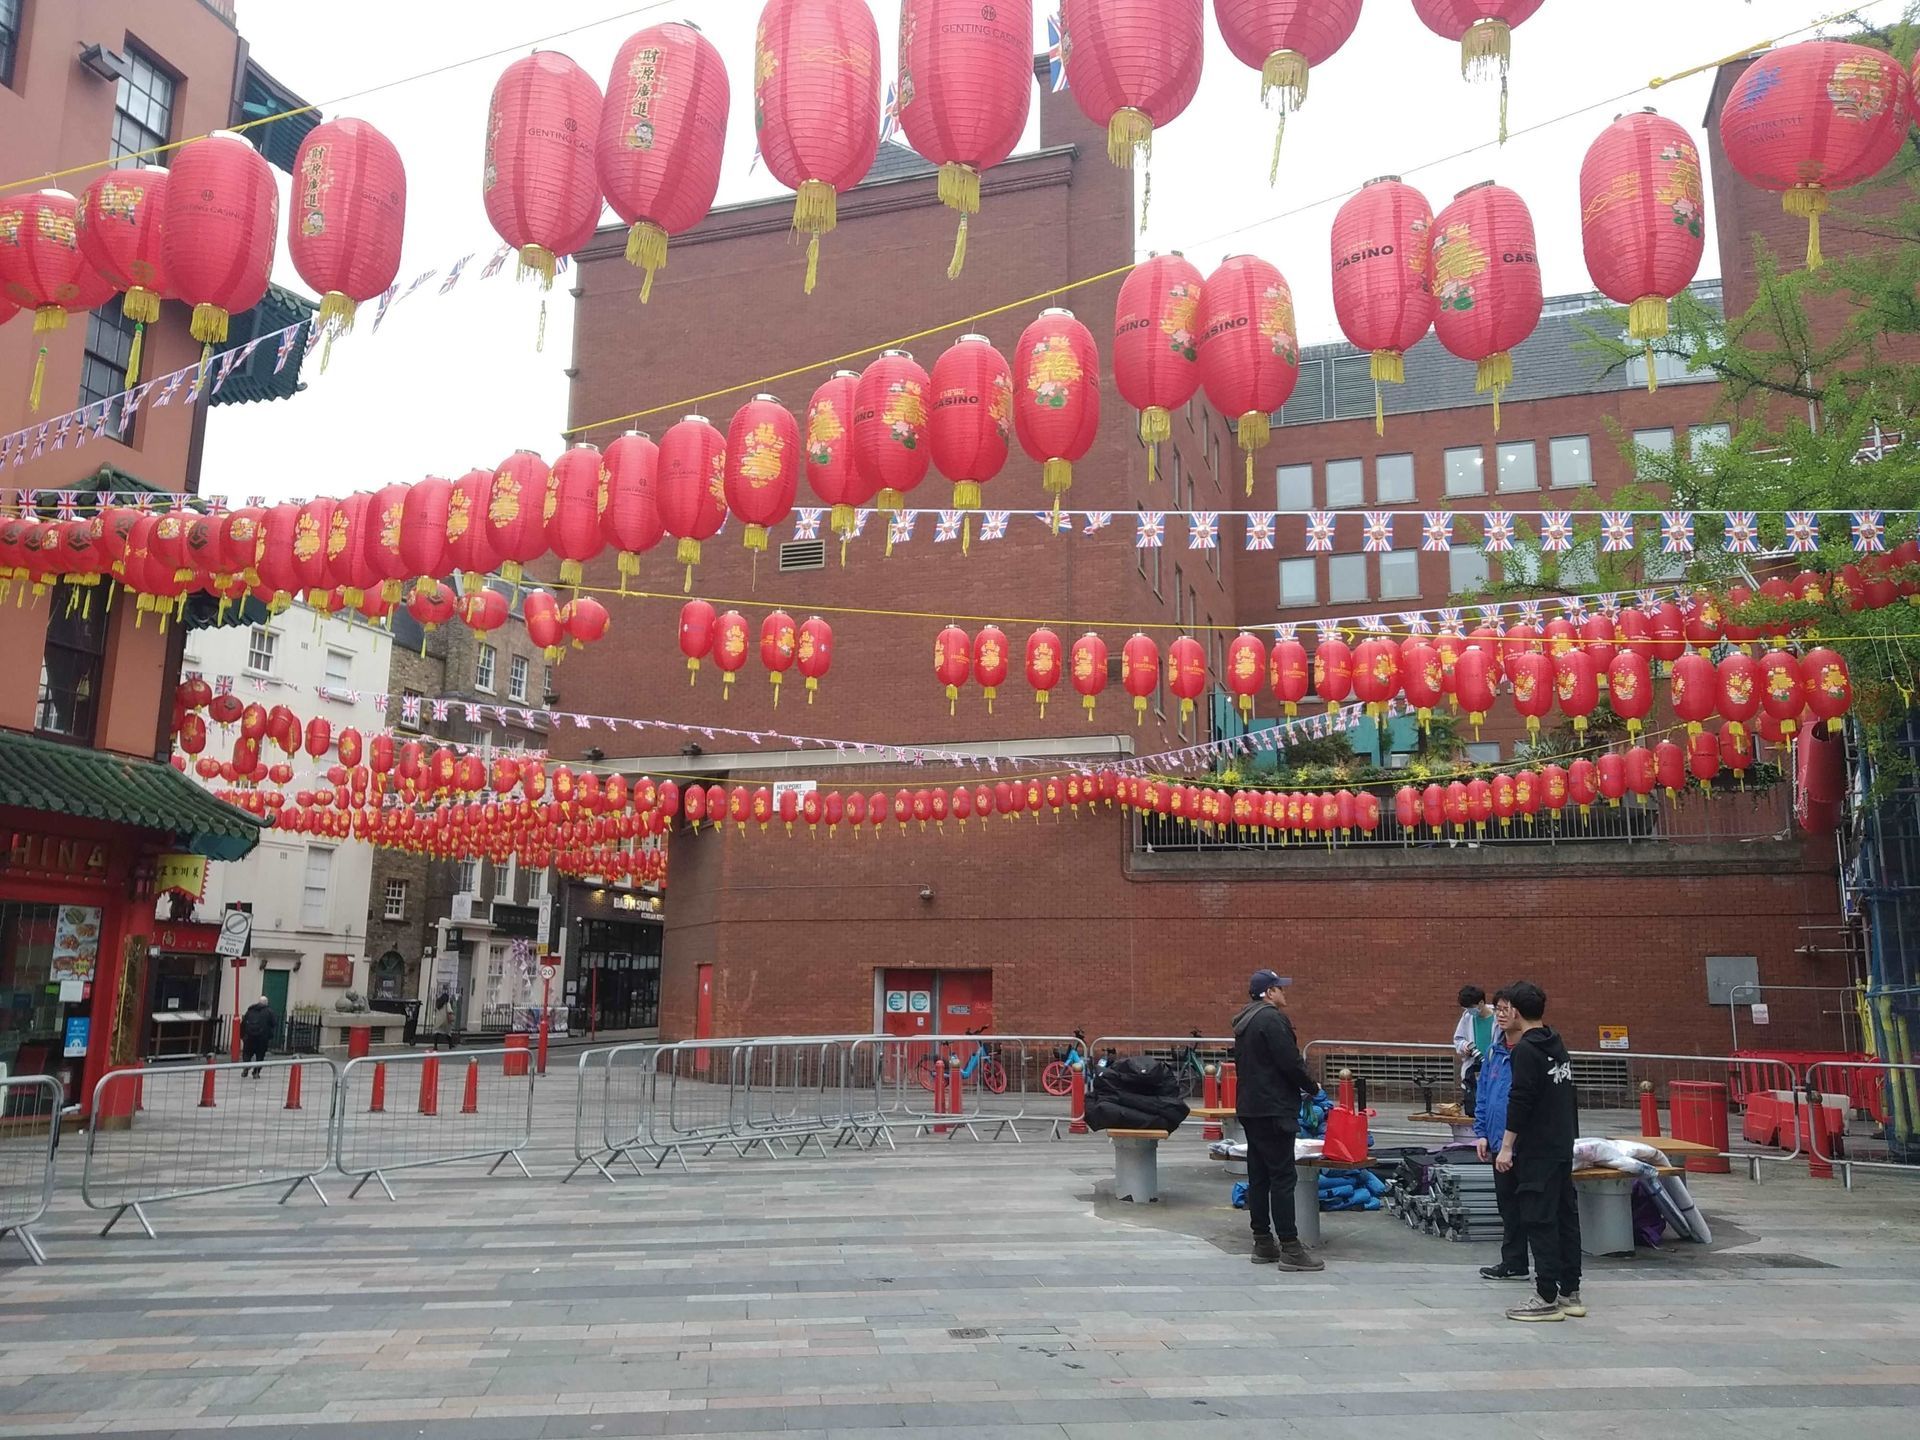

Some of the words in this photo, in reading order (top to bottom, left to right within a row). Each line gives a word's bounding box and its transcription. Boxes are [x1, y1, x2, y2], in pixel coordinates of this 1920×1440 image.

[942, 23, 990, 35] GENTING
[528, 127, 573, 144] GENTING
[1335, 245, 1393, 272] CASINO
[219, 946, 240, 954] ENDS
